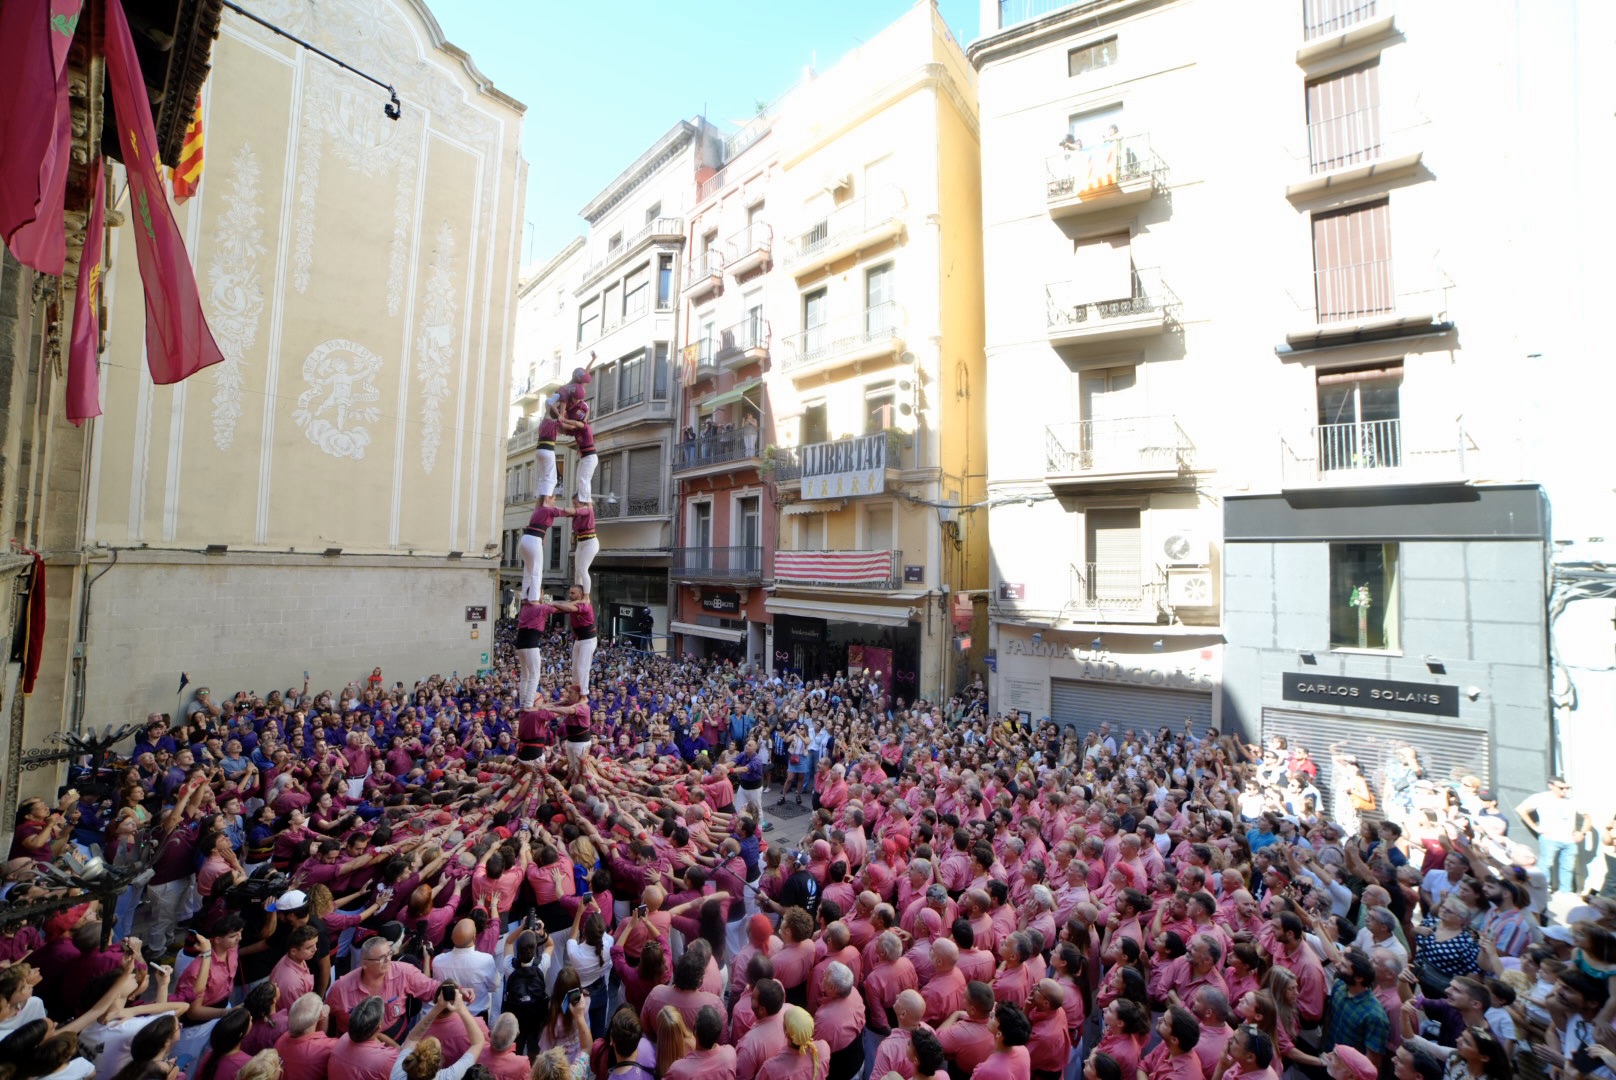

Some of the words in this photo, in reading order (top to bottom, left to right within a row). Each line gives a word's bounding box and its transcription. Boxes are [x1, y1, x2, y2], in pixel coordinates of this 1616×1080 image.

[326, 341, 378, 368] PAHERIA
[802, 434, 885, 478] LLIBERTAT
[1297, 683, 1360, 698] CARLOS
[1370, 688, 1441, 705] SOLANS
